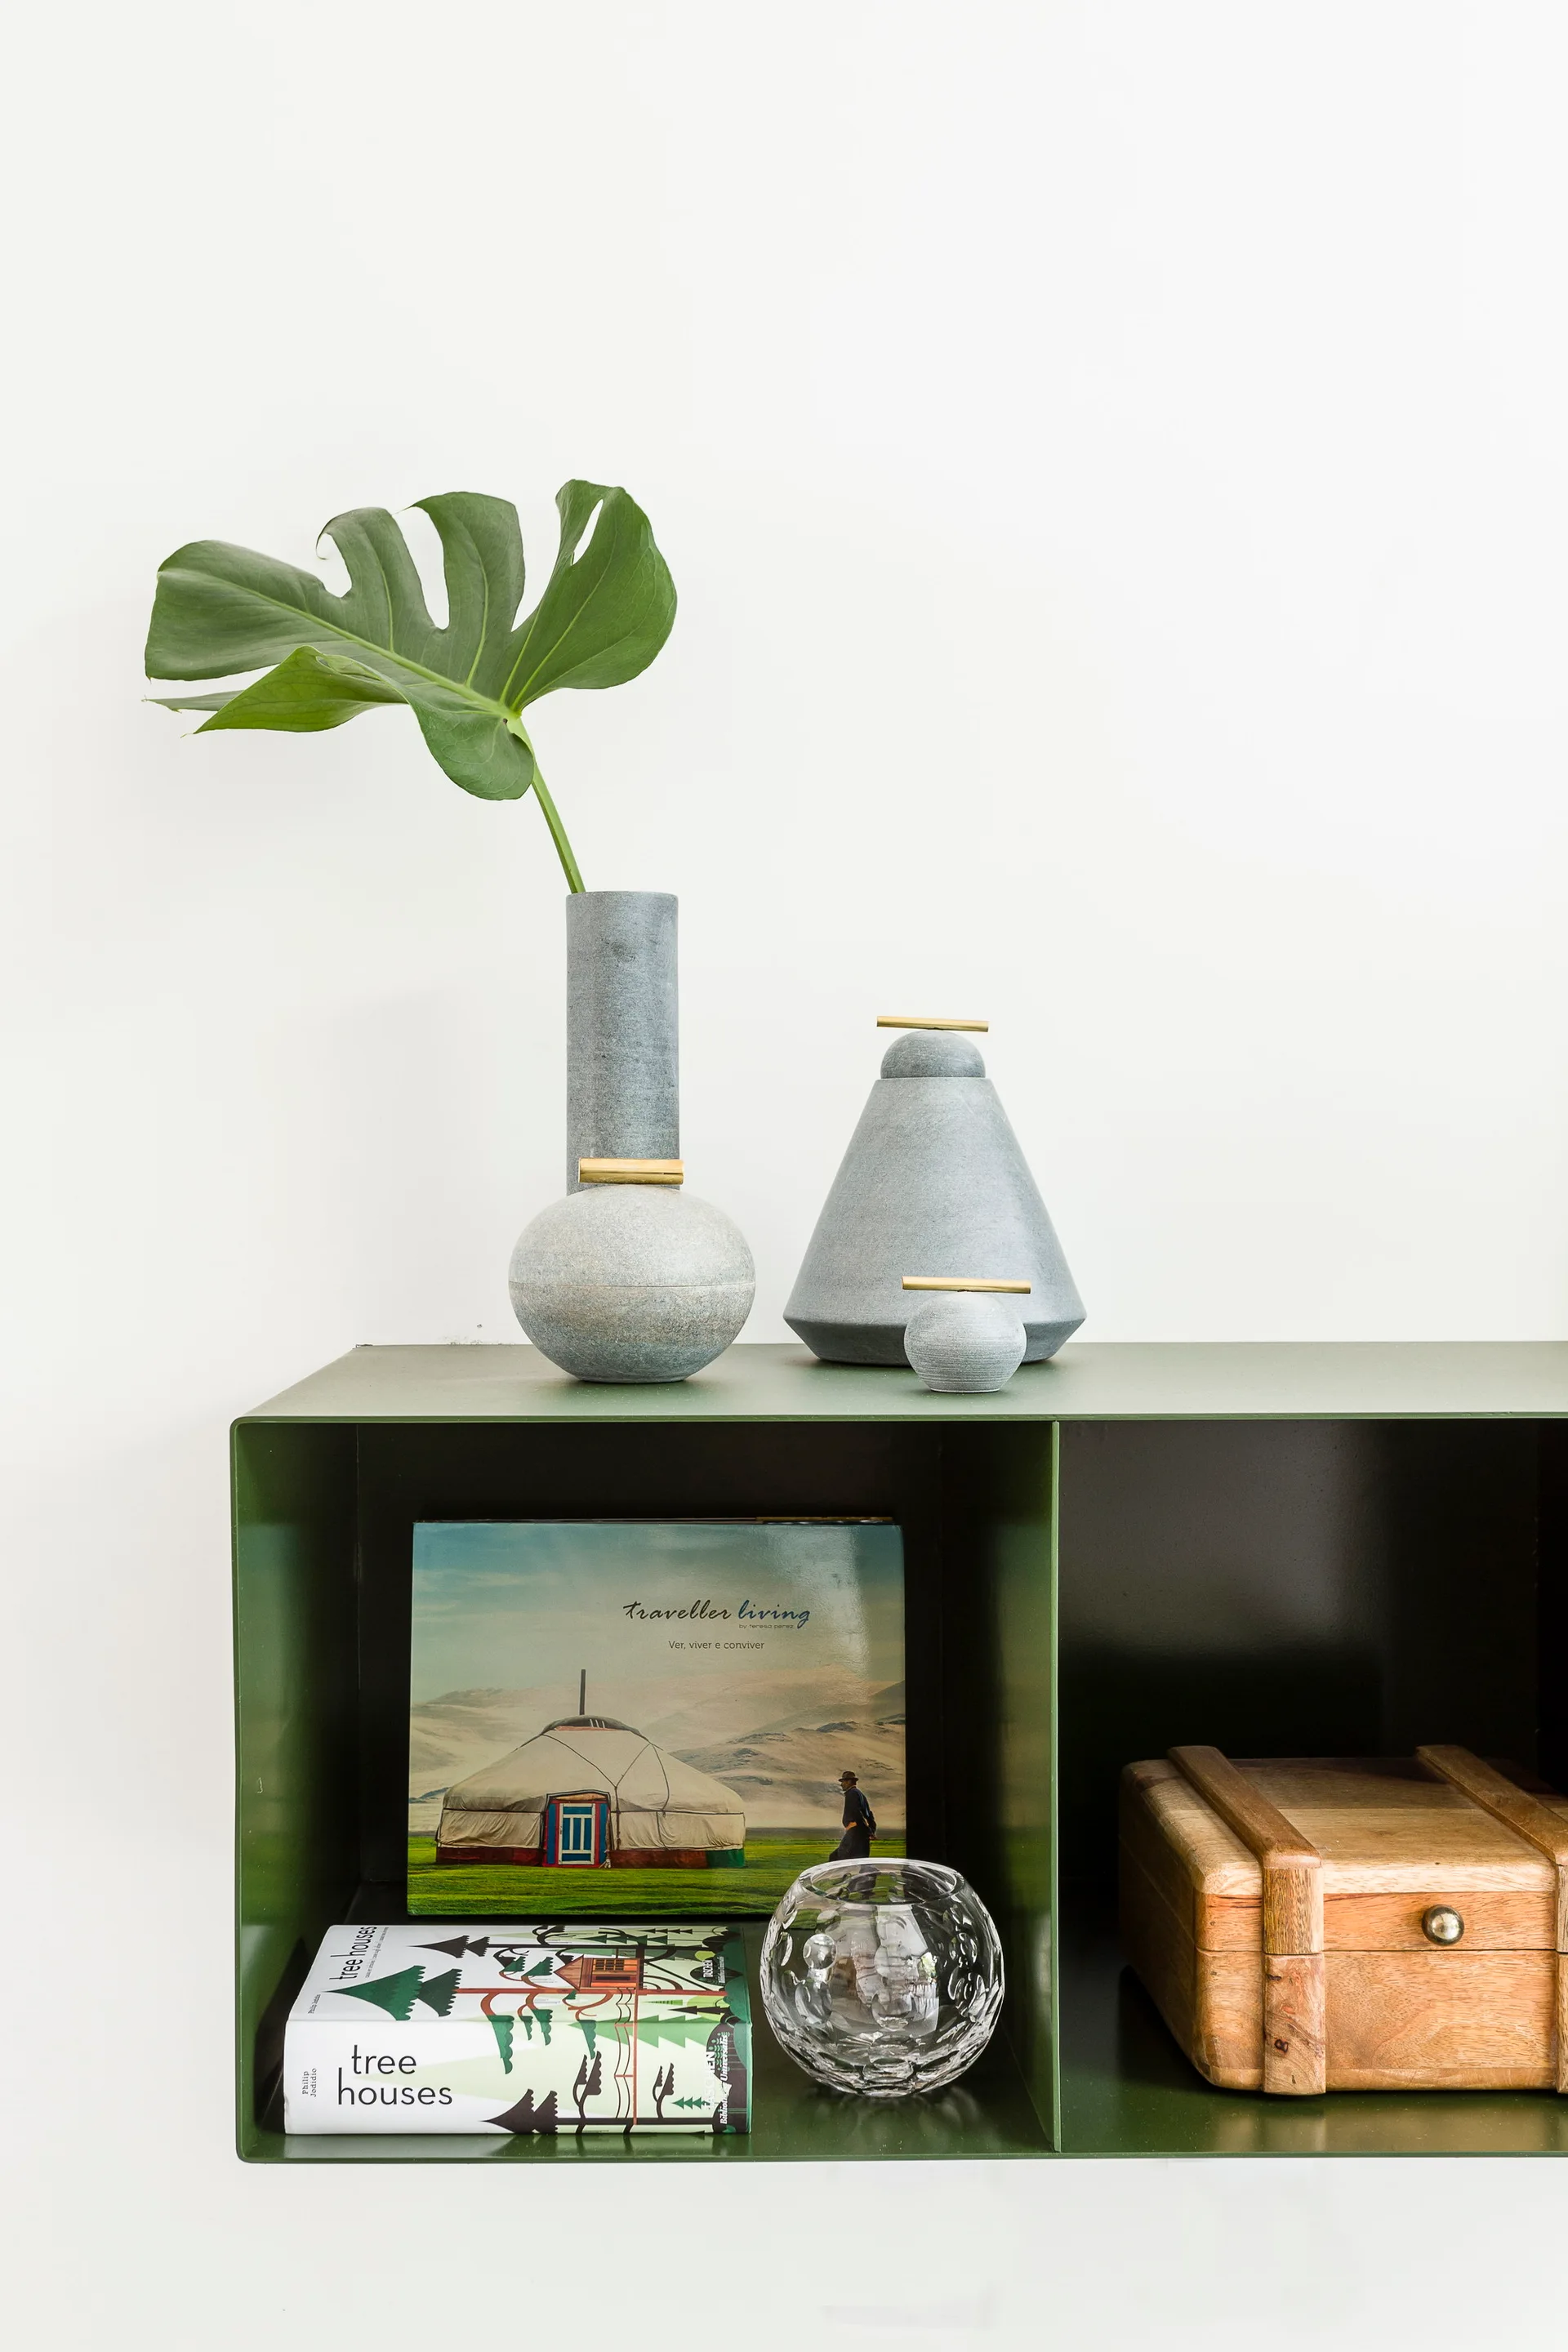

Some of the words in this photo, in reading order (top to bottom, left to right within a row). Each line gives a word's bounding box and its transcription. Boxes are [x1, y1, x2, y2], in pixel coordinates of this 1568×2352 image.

[622, 1599, 732, 1619] traveller
[737, 1599, 811, 1628] living
[668, 1640, 686, 1650] Ver,
[688, 1640, 712, 1650] viver
[724, 1640, 765, 1650] conviver
[330, 1927, 377, 1958] houses
[329, 1959, 363, 1980] tree
[702, 1959, 714, 1978] TASCHEN
[351, 2044, 416, 2074] tree
[301, 2070, 310, 2095] Philip
[337, 2067, 453, 2105] houses
